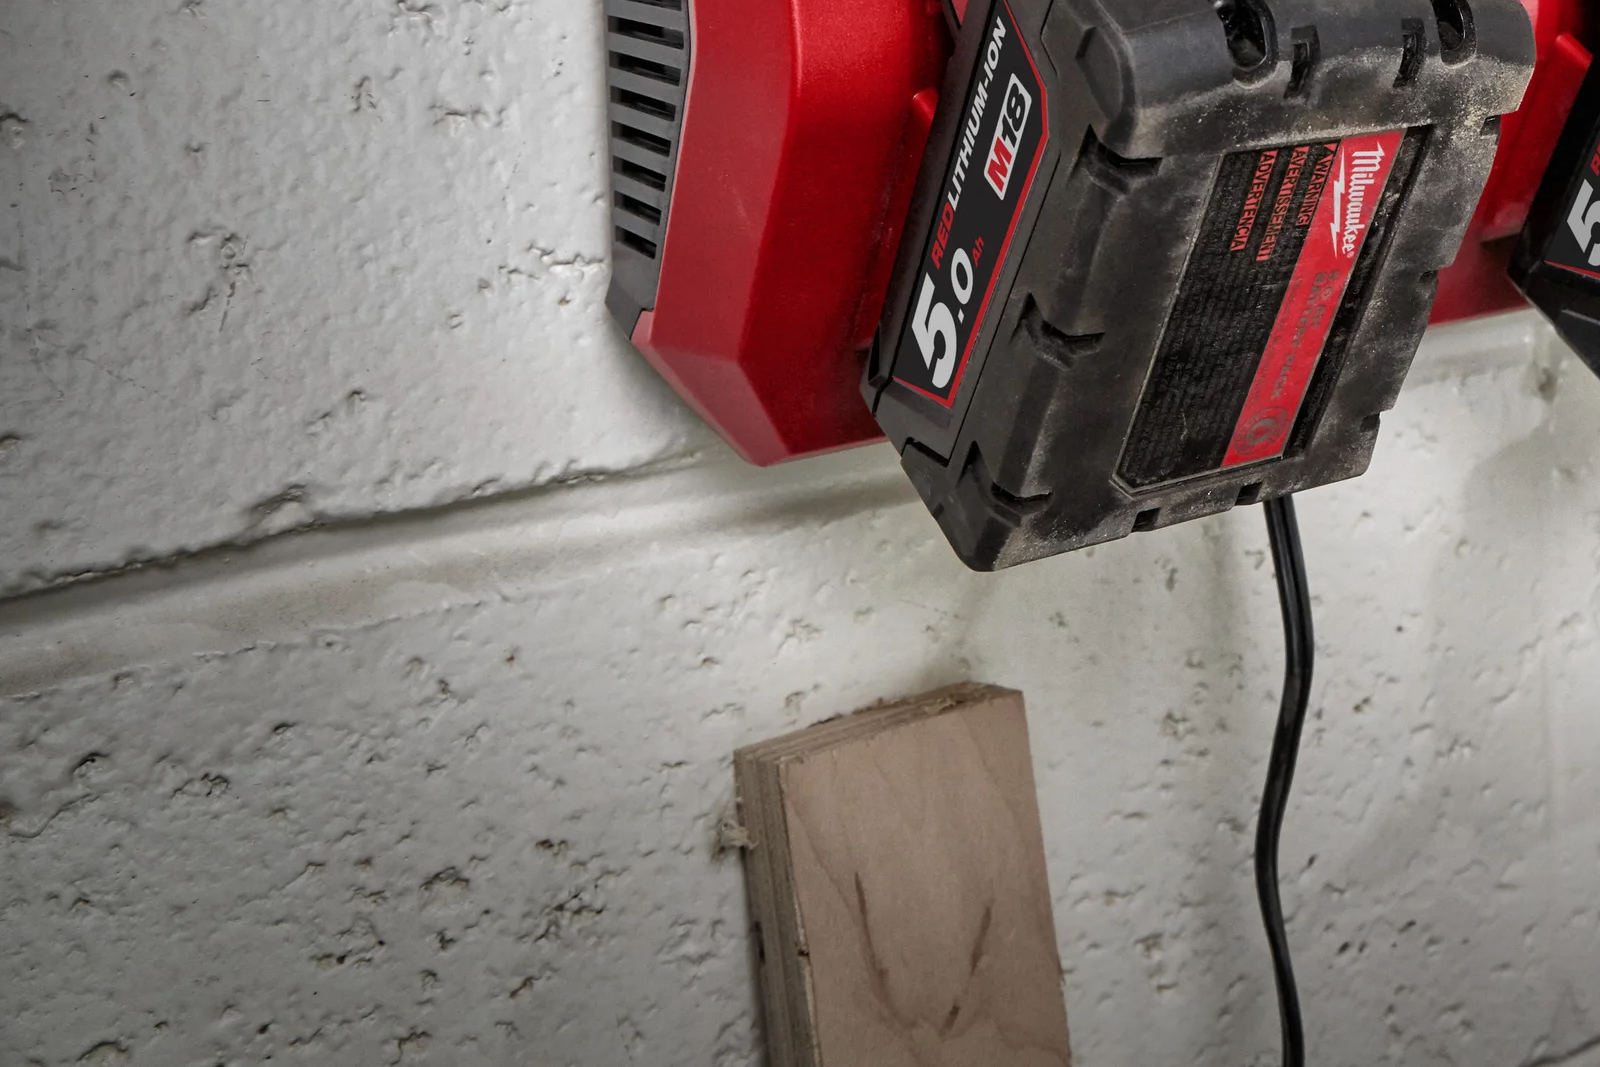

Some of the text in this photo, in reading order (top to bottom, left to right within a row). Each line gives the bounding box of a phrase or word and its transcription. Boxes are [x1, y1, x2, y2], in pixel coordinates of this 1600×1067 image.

[931, 16, 1006, 269] REDLITHIUM-ION
[987, 82, 1026, 193] M18
[1299, 153, 1333, 225] WARNING
[1231, 152, 1275, 251] ADVERTENCIA
[1258, 148, 1307, 261] AVERTISSEMENT
[1342, 141, 1385, 254] Milwaukee
[912, 236, 985, 389] 5.0 Ah
